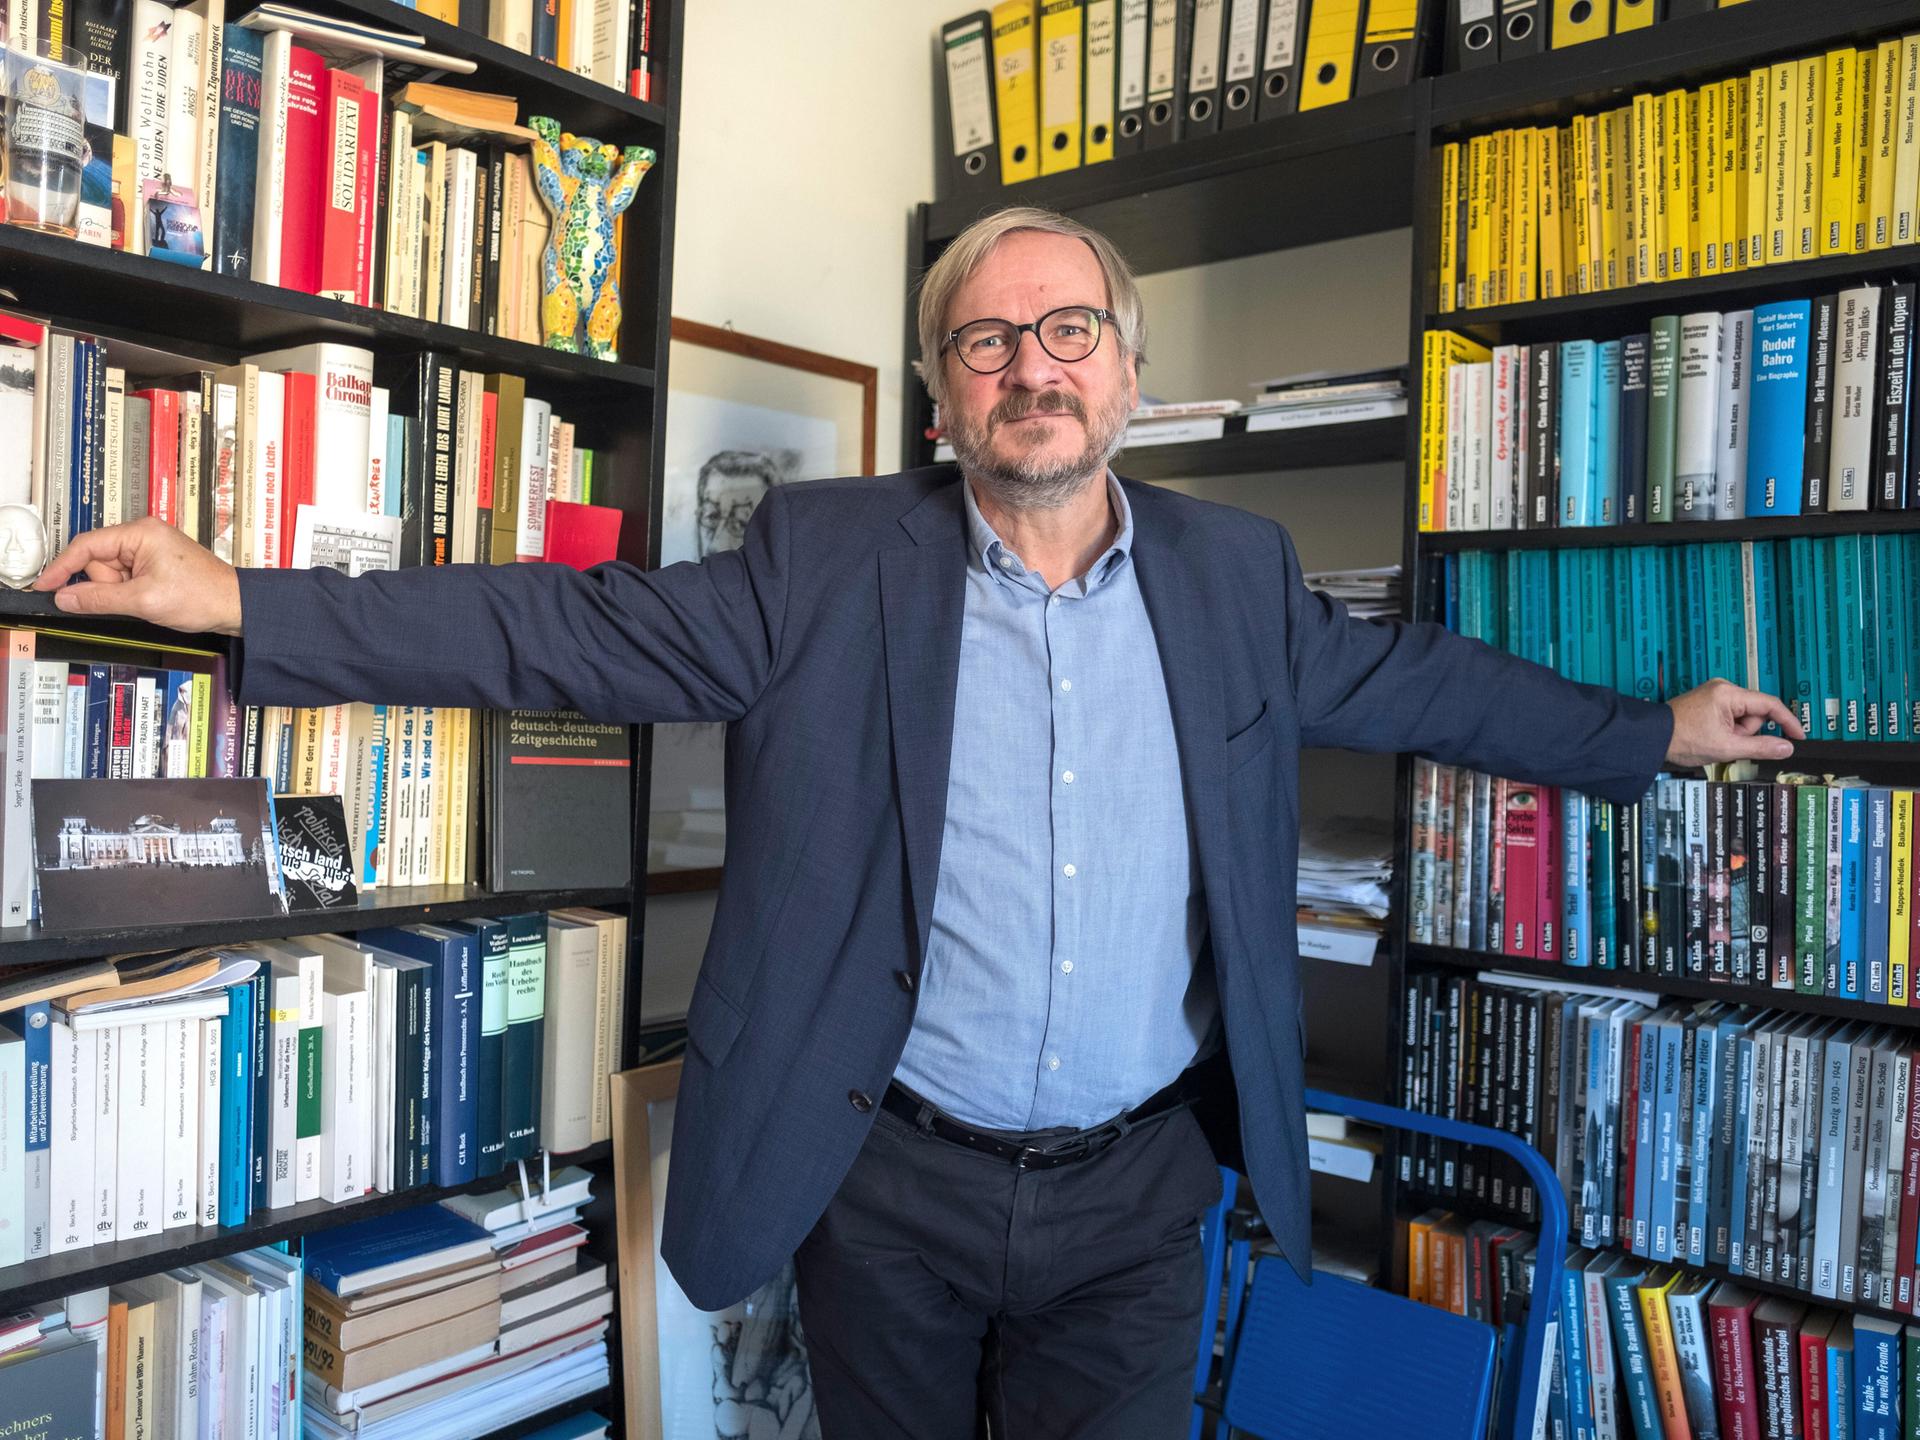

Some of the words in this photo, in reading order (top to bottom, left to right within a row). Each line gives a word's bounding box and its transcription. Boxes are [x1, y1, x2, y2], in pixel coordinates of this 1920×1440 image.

[90, 53, 111, 65] DER
[1836, 57, 1844, 75] Links
[157, 55, 167, 89] JUDEN
[139, 51, 154, 127] Wolffsohn
[1835, 77, 1845, 101] Prinzip
[156, 92, 166, 118] EURE
[1835, 102, 1843, 116] Das
[1883, 96, 1892, 107] der
[1834, 122, 1842, 145] Weber
[154, 129, 164, 161] JUDEN
[1881, 145, 1890, 157] Die
[473, 279, 482, 304] Jürgen
[1844, 299, 1855, 316] dem
[1890, 296, 1908, 333] Tropen
[1818, 305, 1830, 341] Adenauer
[1844, 318, 1855, 337] nach
[1762, 336, 1796, 352] Rudolf
[1817, 342, 1828, 365] hinter
[1842, 339, 1854, 363] Leben
[1891, 335, 1905, 356] den
[1762, 352, 1793, 367] Bahro
[1888, 358, 1903, 368] in
[326, 372, 372, 393] Balkan
[439, 367, 452, 404] LANDAU
[1815, 366, 1827, 387] Mann
[326, 387, 372, 407] Chronik
[1814, 388, 1825, 402] Der
[1887, 370, 1903, 404] Eiszeit
[438, 406, 451, 431] KURT
[83, 425, 91, 445] des
[438, 433, 449, 452] DES
[457, 436, 465, 448] DIE
[107, 407, 119, 502] SOWJETWIRTSCHAFT
[1888, 437, 1897, 455] Bernd
[437, 453, 449, 482] LEBEN
[548, 452, 559, 466] der
[83, 446, 91, 504] Geschichte
[265, 472, 275, 494] noch
[436, 483, 448, 513] KURZE
[527, 465, 539, 530] SOMMERFEST
[53, 501, 62, 526] Weber
[263, 497, 275, 529] brennt
[435, 515, 447, 534] DAS
[17, 643, 29, 652] 16
[141, 696, 149, 711] HAFT
[141, 712, 148, 720] IN
[307, 714, 317, 727] die
[140, 720, 148, 744] FRAUEN
[307, 728, 315, 743] und
[404, 719, 413, 736] das
[423, 719, 433, 736] das
[511, 720, 622, 735] deutsch-deutschen
[224, 738, 236, 761] Staat
[330, 739, 340, 758] Lutz
[402, 740, 412, 759] sind
[422, 740, 432, 759] sind
[511, 733, 598, 748] Zeitgeschichte
[306, 745, 314, 762] Gott
[355, 736, 364, 785] VEREINIGUNG
[401, 762, 411, 778] Wir
[421, 762, 431, 778] Wir
[1715, 787, 1723, 816] werden
[1692, 787, 1700, 838] Entkommen
[1807, 794, 1816, 847] Meisterschaft
[1873, 800, 1886, 847] Eingewandert
[1898, 799, 1907, 847] Balkan-Mafia
[314, 849, 343, 871] land
[1716, 857, 1724, 872] und
[1758, 849, 1766, 872] gegen
[1807, 849, 1815, 864] und
[521, 968, 533, 976] des
[516, 983, 536, 994] rechts
[423, 1033, 431, 1046] des
[1699, 1039, 1709, 1065] Hitler
[1726, 1034, 1737, 1072] Pullach
[1664, 1041, 1676, 1094] Wolfsschanze
[1832, 1060, 1842, 1079] 1945
[1856, 1056, 1868, 1074] Burg
[38, 1064, 48, 1125] Zielvereinbarung
[1698, 1068, 1708, 1106] Nachbar
[1830, 1086, 1840, 1105] 1930
[1854, 1075, 1866, 1109] Krakauer
[29, 1061, 40, 1143] Mitarbeiterbeurteilung
[1722, 1074, 1734, 1144] Geheimobjekt
[1828, 1108, 1841, 1137] Danzig
[39, 1127, 47, 1142] und
[173, 1209, 188, 1220] dtv
[205, 1204, 215, 1220] dtv
[97, 1221, 113, 1231] dtv
[133, 1220, 149, 1230] dtv
[33, 1226, 42, 1250] Haufe
[65, 1233, 80, 1244] dtv
[1617, 1285, 1631, 1311] Erfurt
[1623, 1312, 1632, 1321] in
[1627, 1322, 1639, 1351] Brandt
[1717, 1317, 1727, 1337] Welt
[189, 1329, 198, 1361] Reclam
[1719, 1338, 1728, 1352] die
[1731, 1318, 1744, 1387] Büchermenschen
[1776, 1330, 1789, 1373] Machtspiel
[1631, 1354, 1643, 1374] Willy
[1721, 1353, 1730, 1361] in
[1762, 1338, 1776, 1391] Deutschlands
[1876, 1342, 1889, 1373] Fremde
[188, 1362, 198, 1384] Jahre
[1722, 1363, 1731, 1381] kam
[188, 1385, 197, 1398] 150
[1724, 1383, 1733, 1401] Und
[1877, 1374, 1889, 1398] weiße
[1735, 1390, 1745, 1403] der
[1779, 1376, 1794, 1435] weltpolitisches
[1862, 1385, 1874, 1412] Kirahé
[1766, 1392, 1780, 1438] Vereinigung
[1877, 1399, 1889, 1416] Der
